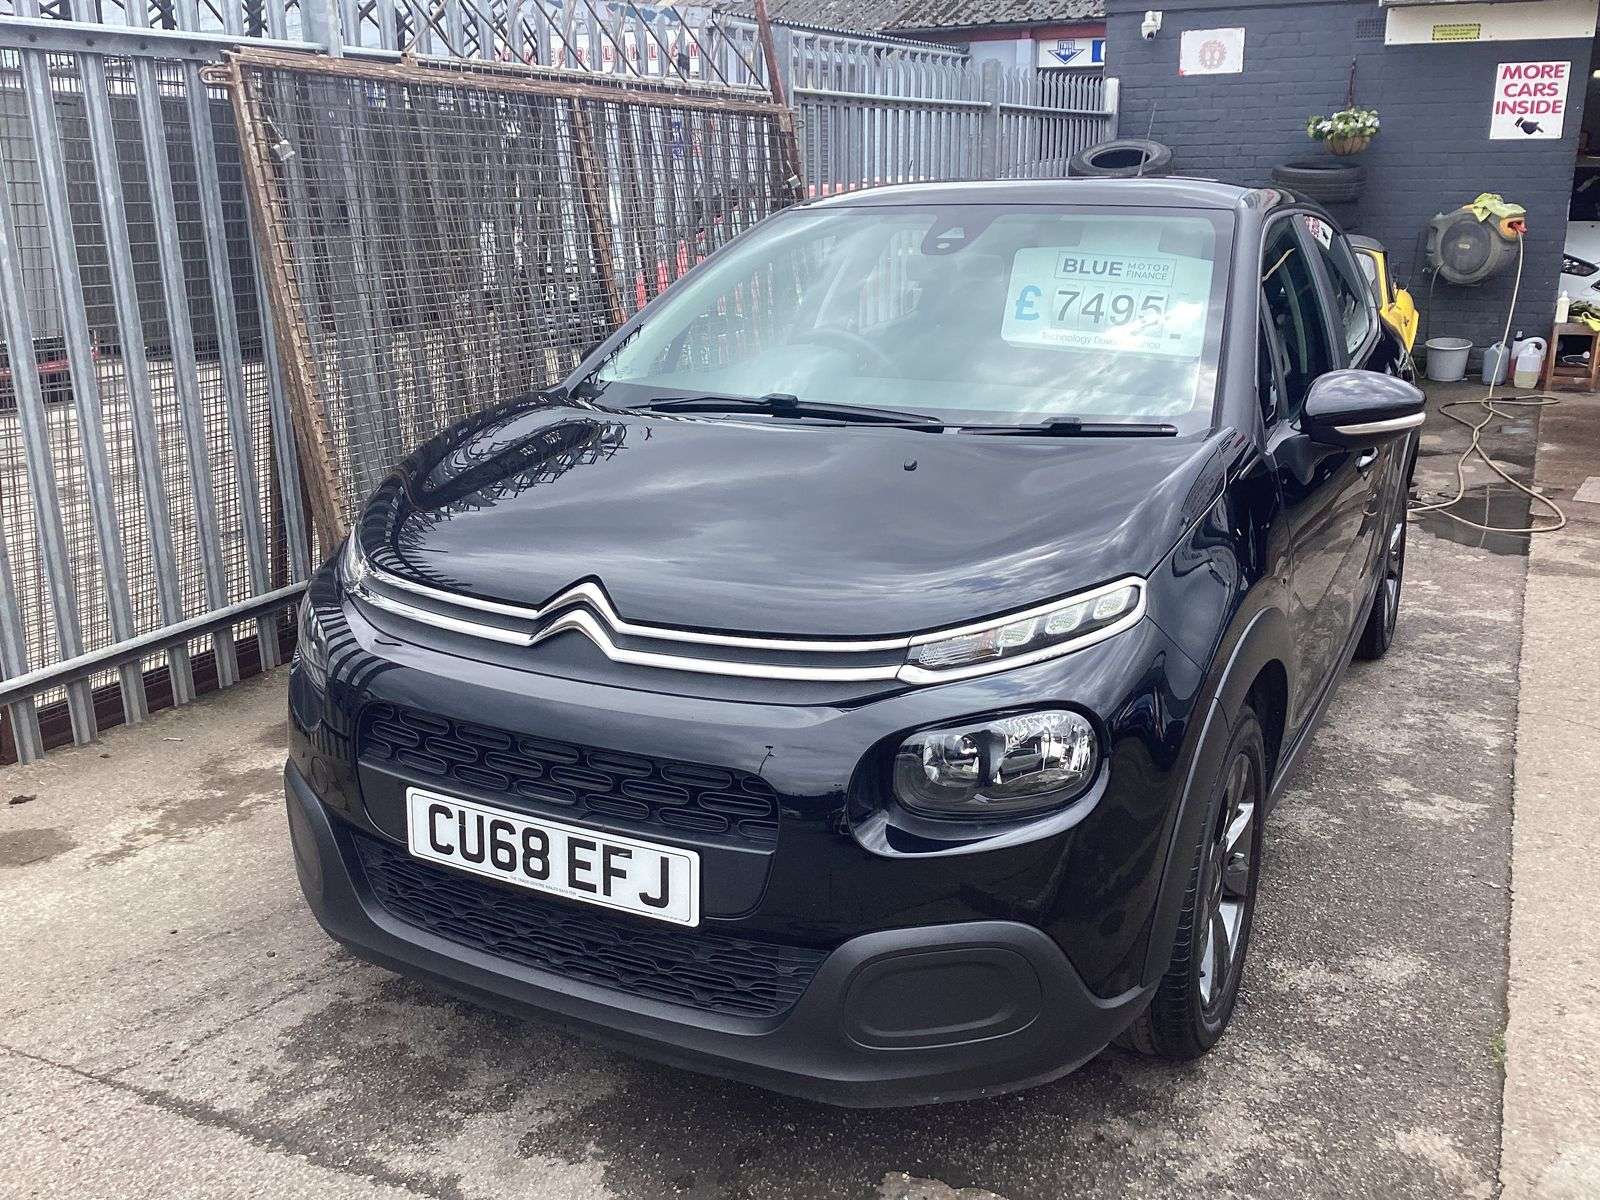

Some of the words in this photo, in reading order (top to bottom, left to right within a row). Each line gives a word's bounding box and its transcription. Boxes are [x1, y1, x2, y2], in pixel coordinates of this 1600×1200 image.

[1502, 64, 1566, 80] MORE
[1503, 82, 1559, 98] CARS
[1495, 100, 1563, 115] INSIDE
[1062, 258, 1124, 277] BLUE
[1127, 262, 1170, 272] MOTOR
[1126, 270, 1168, 281] FINANCE
[1057, 290, 1165, 329] 7495
[428, 803, 550, 881] CU68
[567, 836, 669, 909] EFJ
